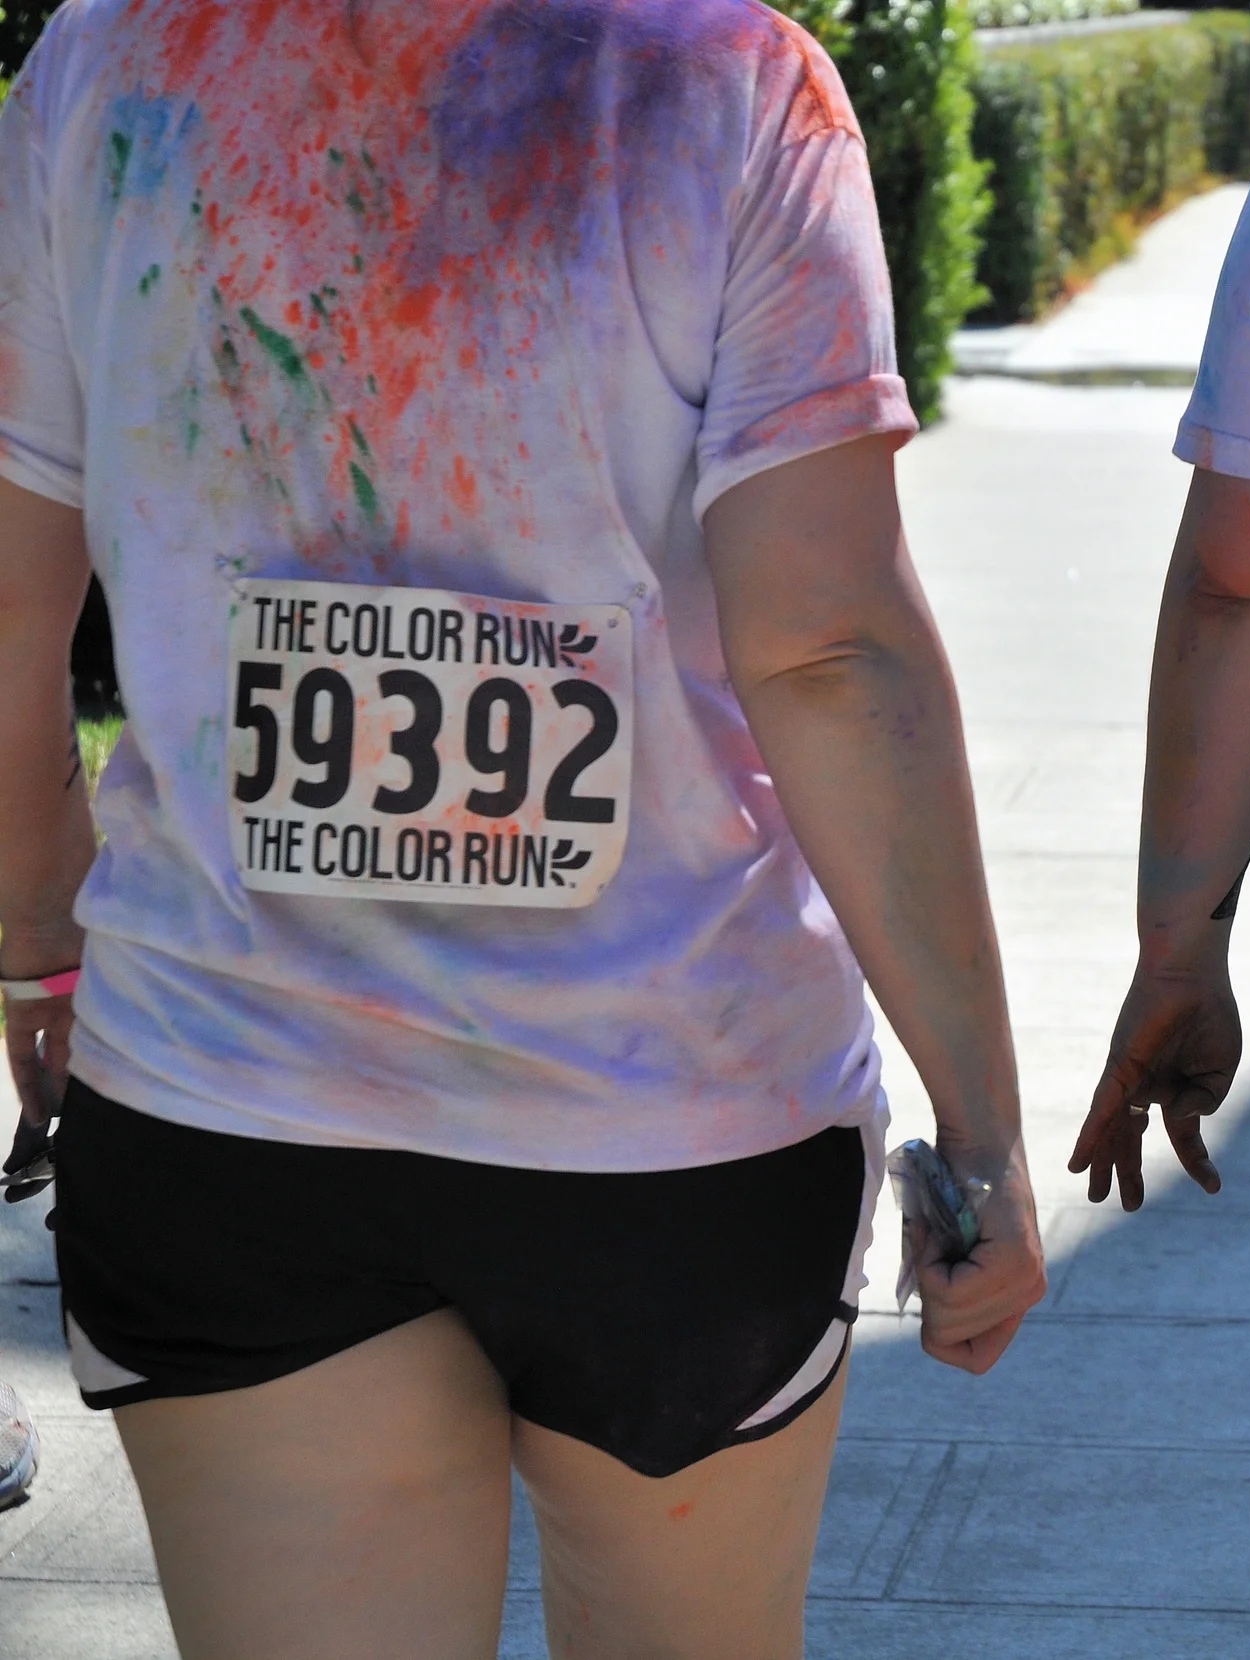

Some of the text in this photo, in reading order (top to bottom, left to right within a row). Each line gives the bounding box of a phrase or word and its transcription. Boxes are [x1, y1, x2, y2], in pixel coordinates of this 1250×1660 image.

[254, 597, 557, 668] THE COLOR RUN
[233, 660, 619, 824] 59392
[243, 816, 548, 888] THE COLOR RUN
